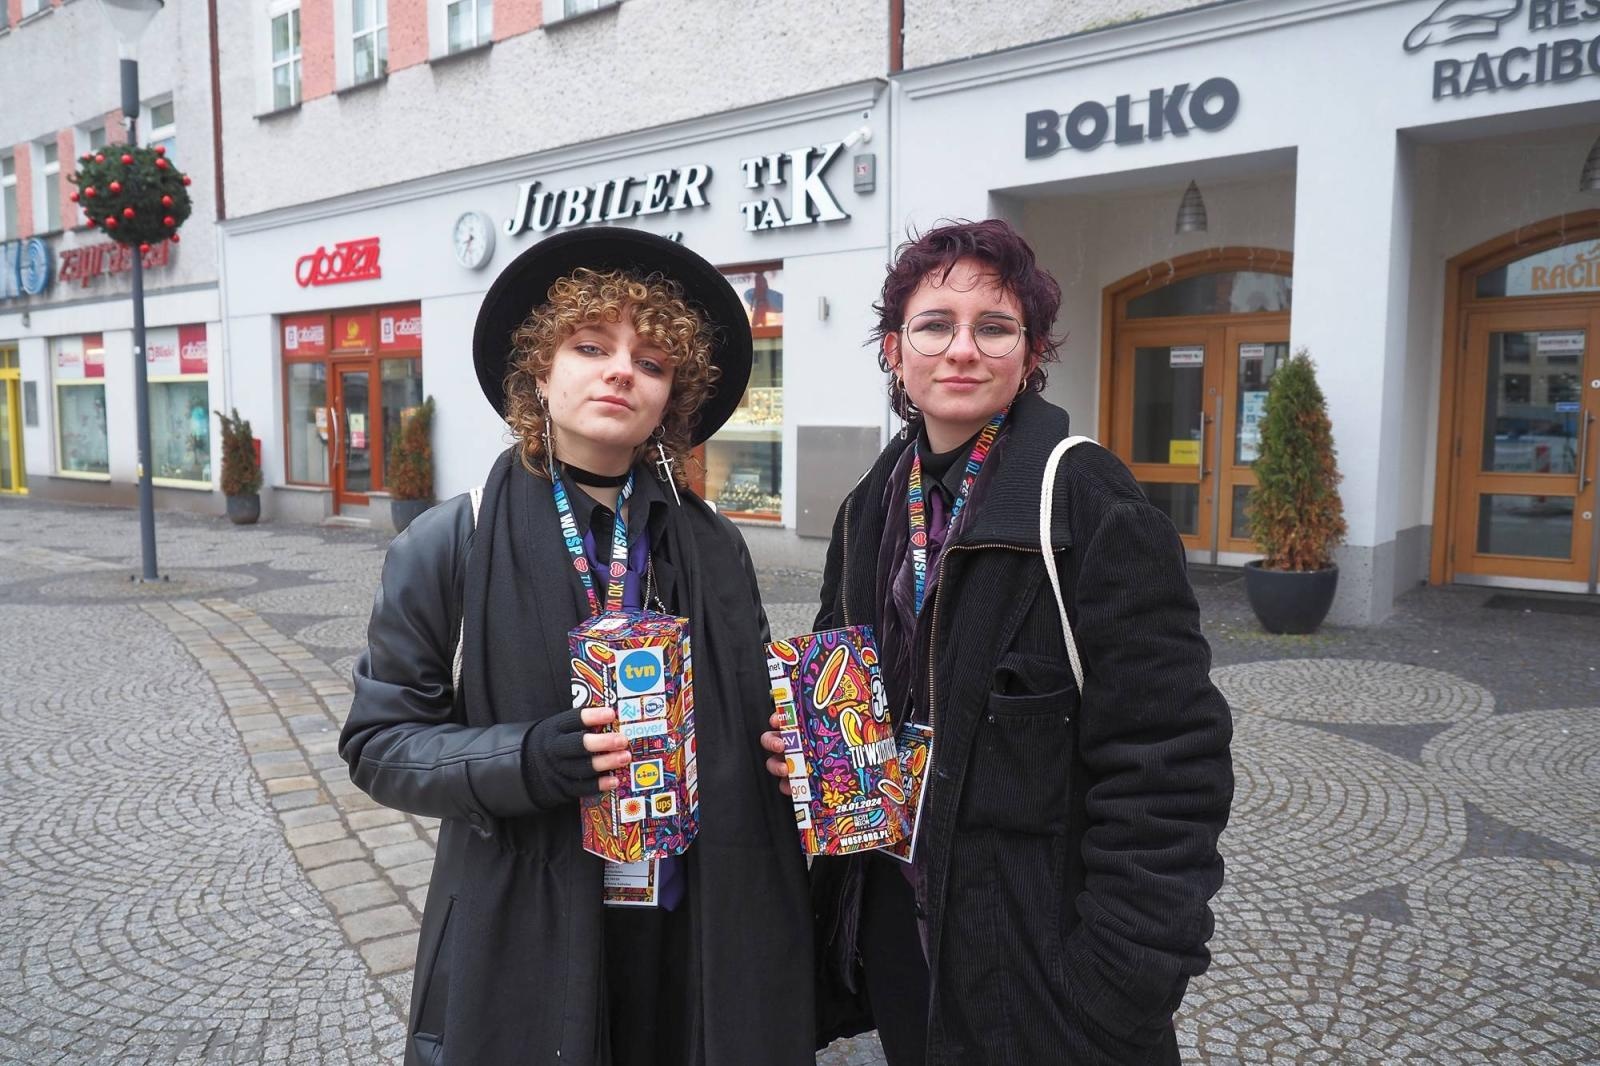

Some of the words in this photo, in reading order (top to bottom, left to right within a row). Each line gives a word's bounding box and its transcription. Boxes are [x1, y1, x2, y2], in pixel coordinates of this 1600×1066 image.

[1025, 77, 1240, 160] BOLKO
[503, 163, 712, 237] JUBILER
[560, 512, 583, 555] WOŚP
[624, 664, 655, 681] tvn
[849, 745, 865, 769] TU
[656, 801, 672, 813] ups
[836, 797, 882, 813] 28.01.2024
